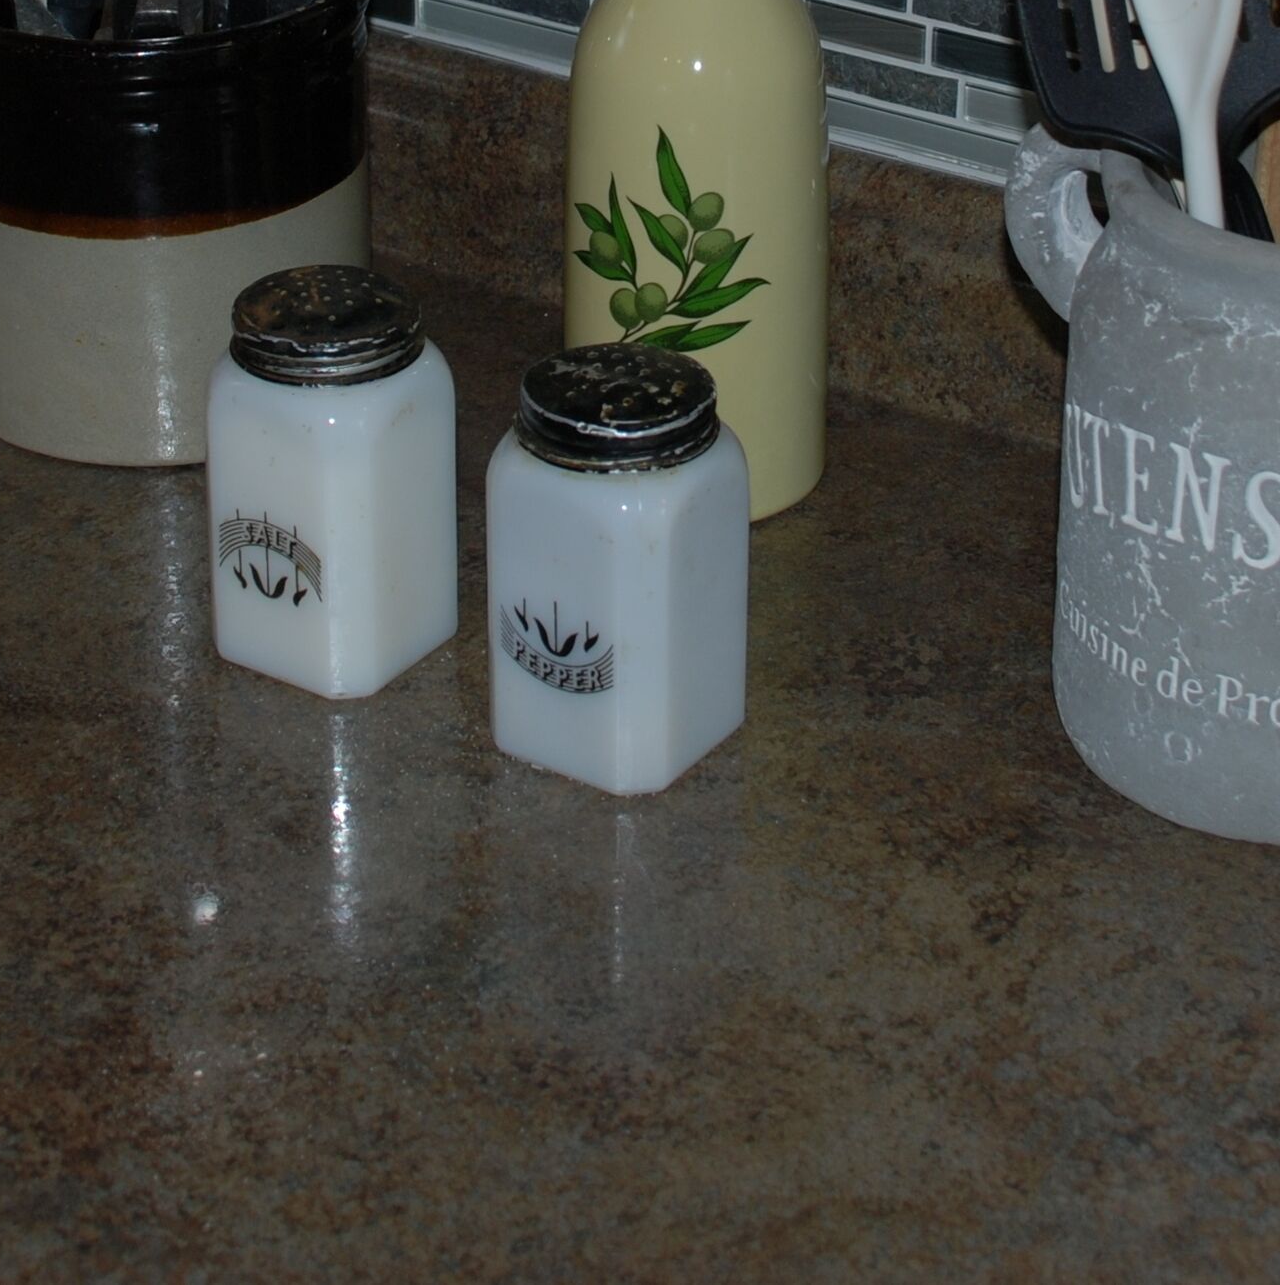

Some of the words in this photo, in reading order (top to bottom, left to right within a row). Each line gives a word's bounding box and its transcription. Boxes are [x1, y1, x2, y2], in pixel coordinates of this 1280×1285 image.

[241, 522, 297, 559] SALT
[514, 636, 605, 692] PEPPER
[1156, 655, 1204, 707] de
